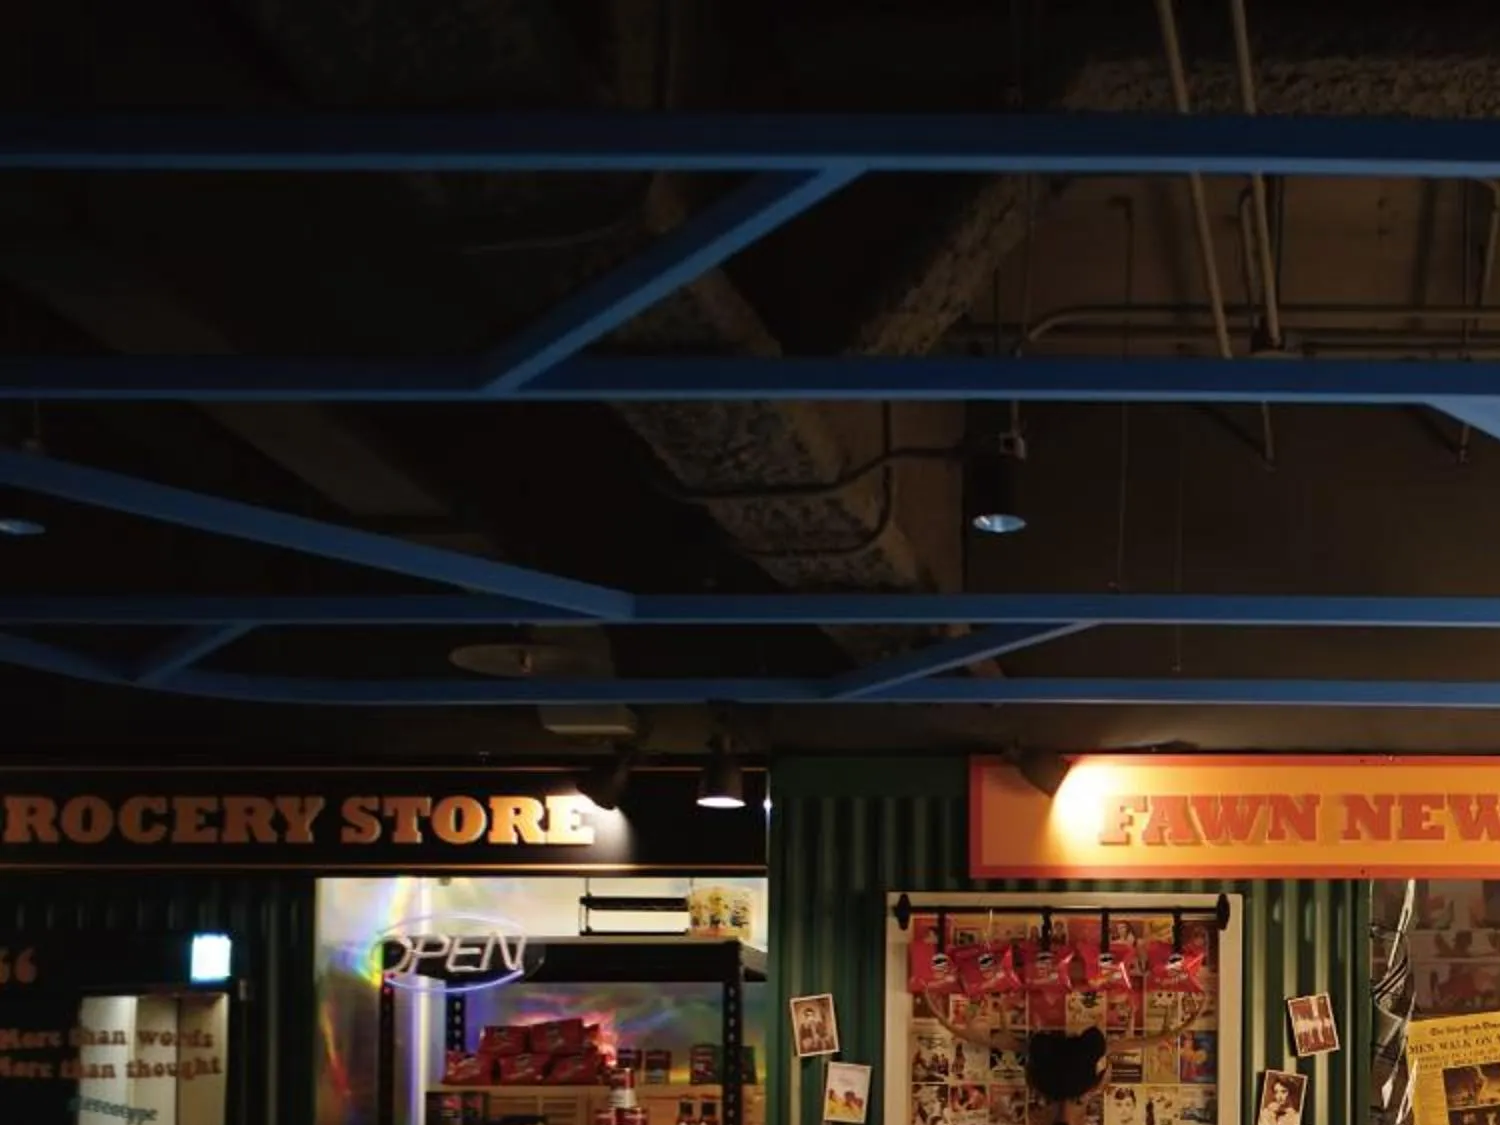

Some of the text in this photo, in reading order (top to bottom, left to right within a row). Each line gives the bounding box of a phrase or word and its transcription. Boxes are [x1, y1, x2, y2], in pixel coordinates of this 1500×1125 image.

[340, 794, 595, 846] STORE
[1098, 793, 1321, 846] FAWN
[374, 930, 528, 976] OPEN
[69, 1026, 127, 1047] than
[139, 1028, 215, 1048] words
[61, 1058, 116, 1079] than
[126, 1056, 223, 1081] thought
